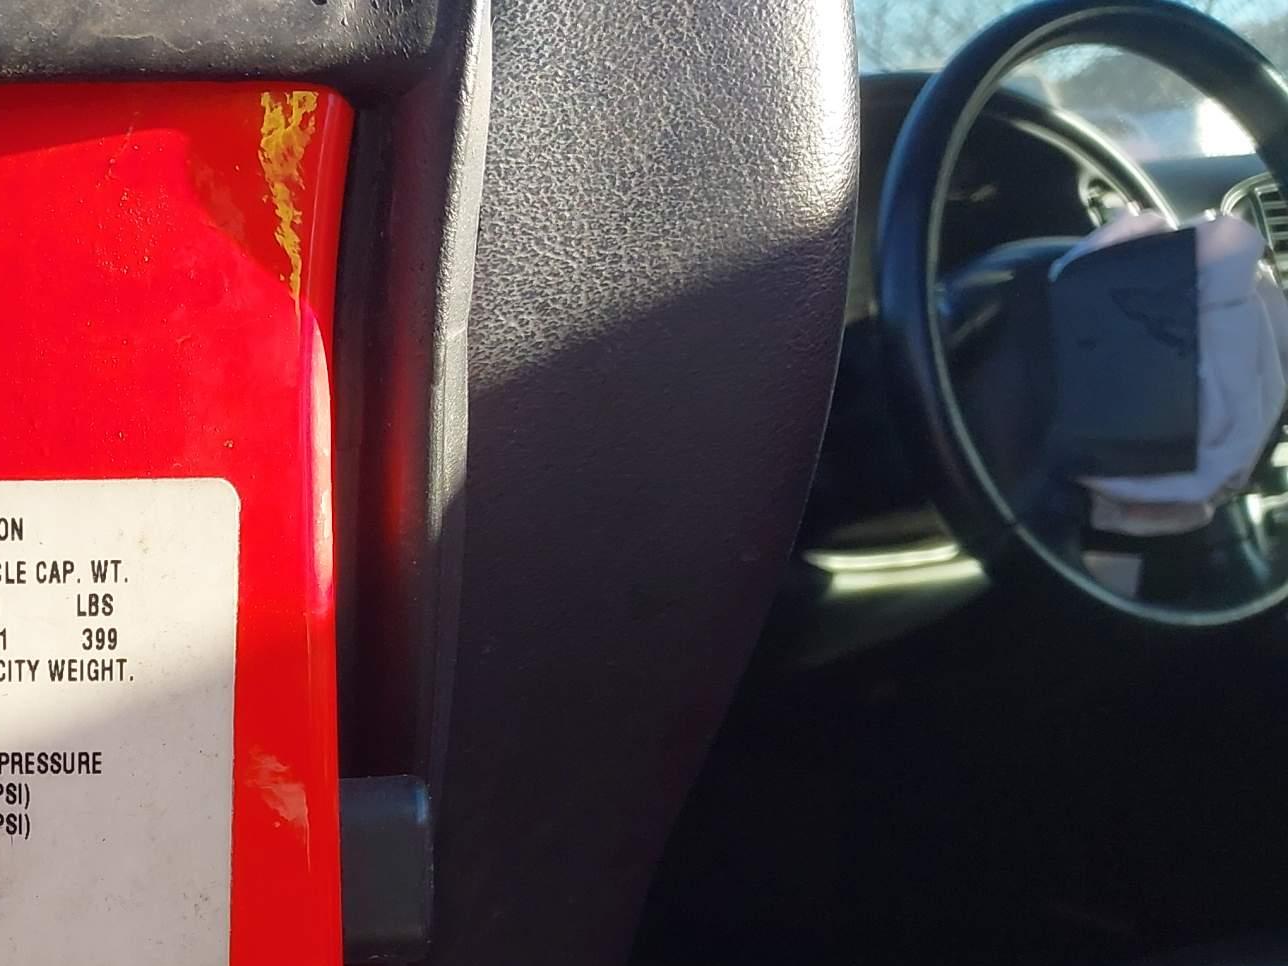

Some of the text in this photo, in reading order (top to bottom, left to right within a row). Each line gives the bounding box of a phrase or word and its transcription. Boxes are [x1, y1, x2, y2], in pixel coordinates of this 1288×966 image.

[36, 561, 81, 585] CAP.
[91, 560, 128, 584] WT.
[76, 593, 114, 618] LBS
[82, 627, 118, 651] 399
[48, 658, 134, 682] WEIGHT.
